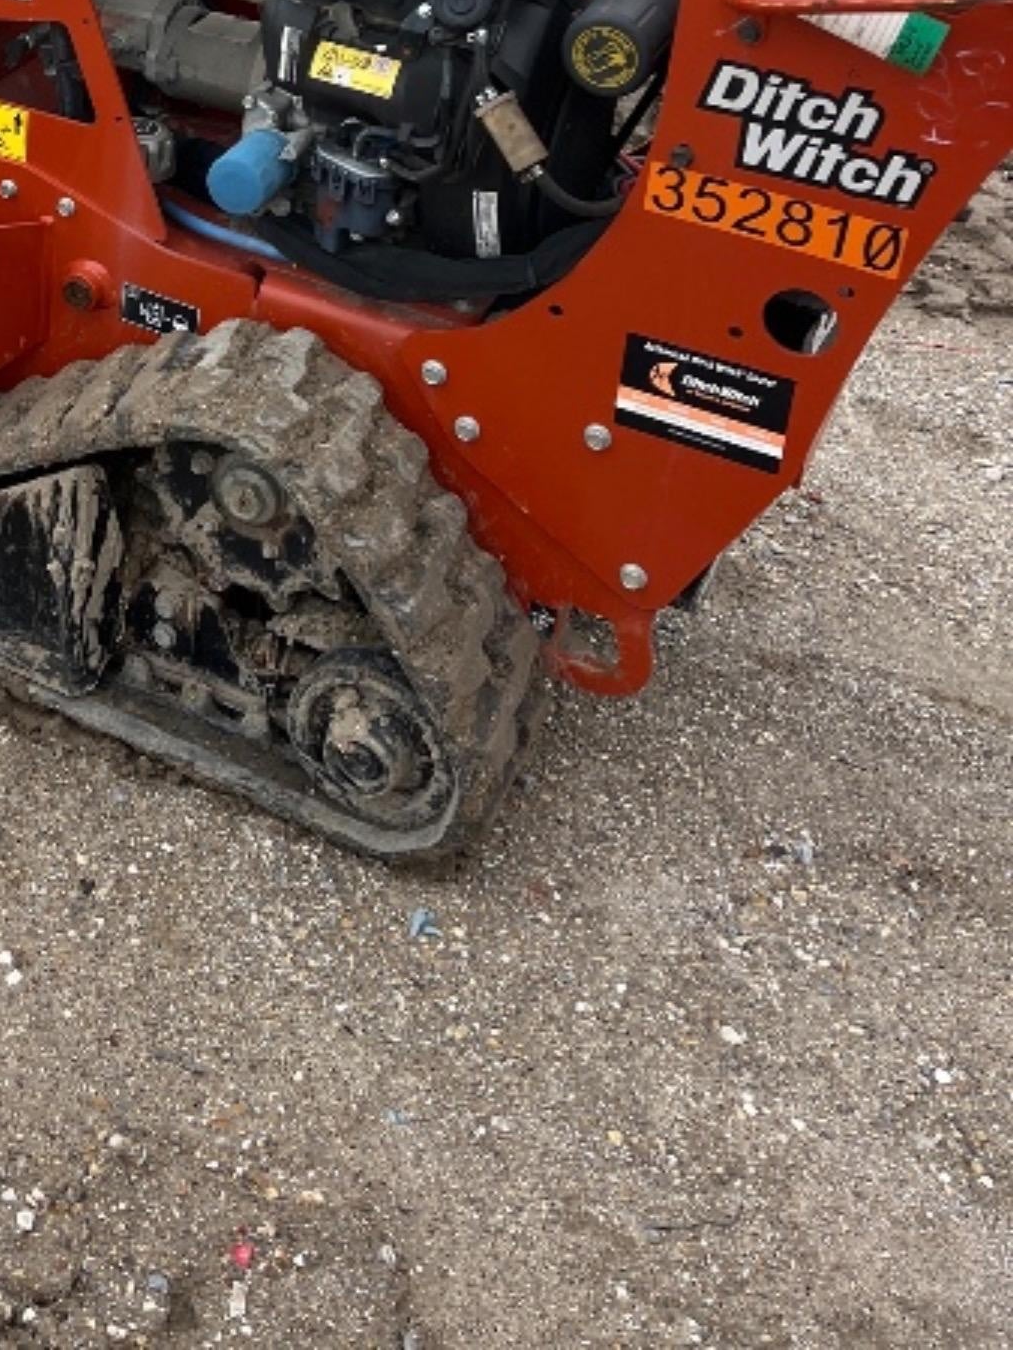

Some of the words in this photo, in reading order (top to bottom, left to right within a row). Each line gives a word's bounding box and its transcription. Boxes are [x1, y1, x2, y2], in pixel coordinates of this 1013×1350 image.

[704, 64, 881, 141] Ditch
[739, 121, 925, 204] Witch
[651, 165, 904, 272] 352810
